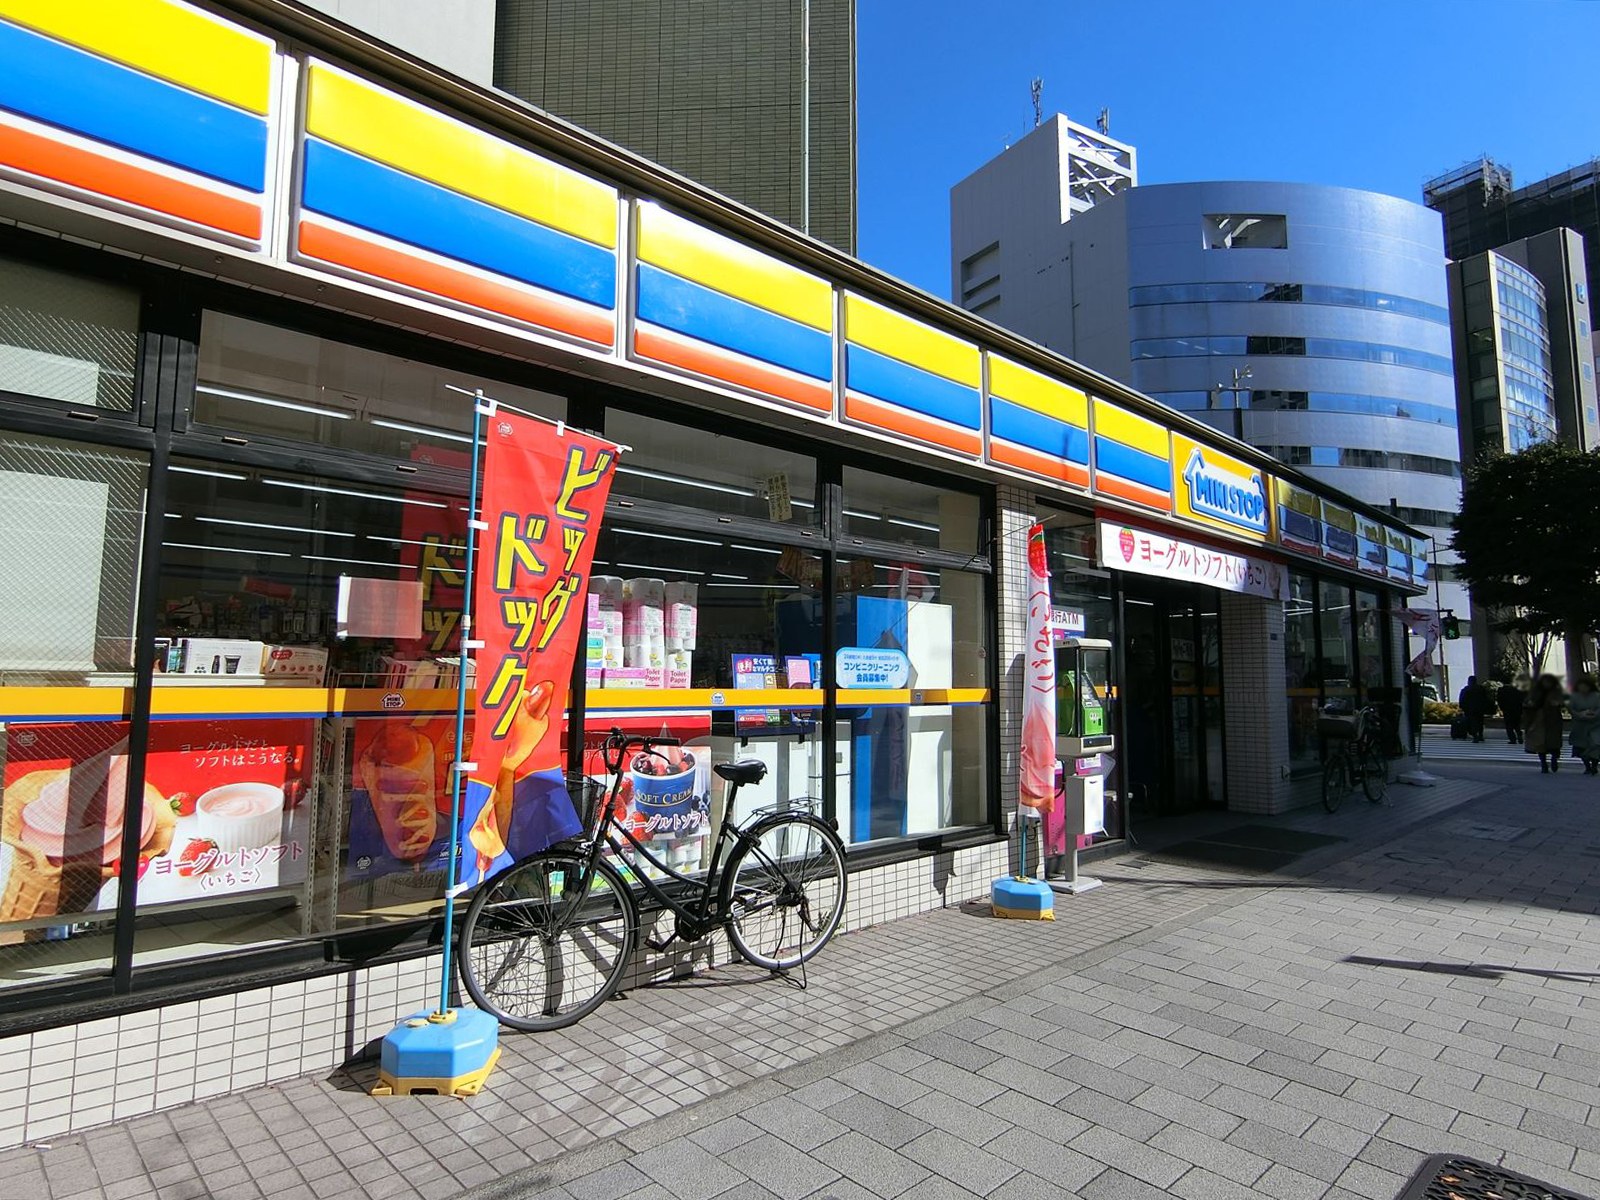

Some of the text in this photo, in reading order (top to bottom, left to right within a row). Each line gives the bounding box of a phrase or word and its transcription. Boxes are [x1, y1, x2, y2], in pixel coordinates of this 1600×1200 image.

[538, 445, 615, 653] ビッグ
[181, 739, 276, 754] ヨーグルトだと、
[195, 752, 300, 768] ソフトはこうなる。
[636, 786, 693, 804] SOFT CREAM
[625, 811, 709, 833] ヨーグルトソフト
[155, 841, 304, 875] ヨーグルトソフト
[200, 868, 263, 890] 〈いちご〉
